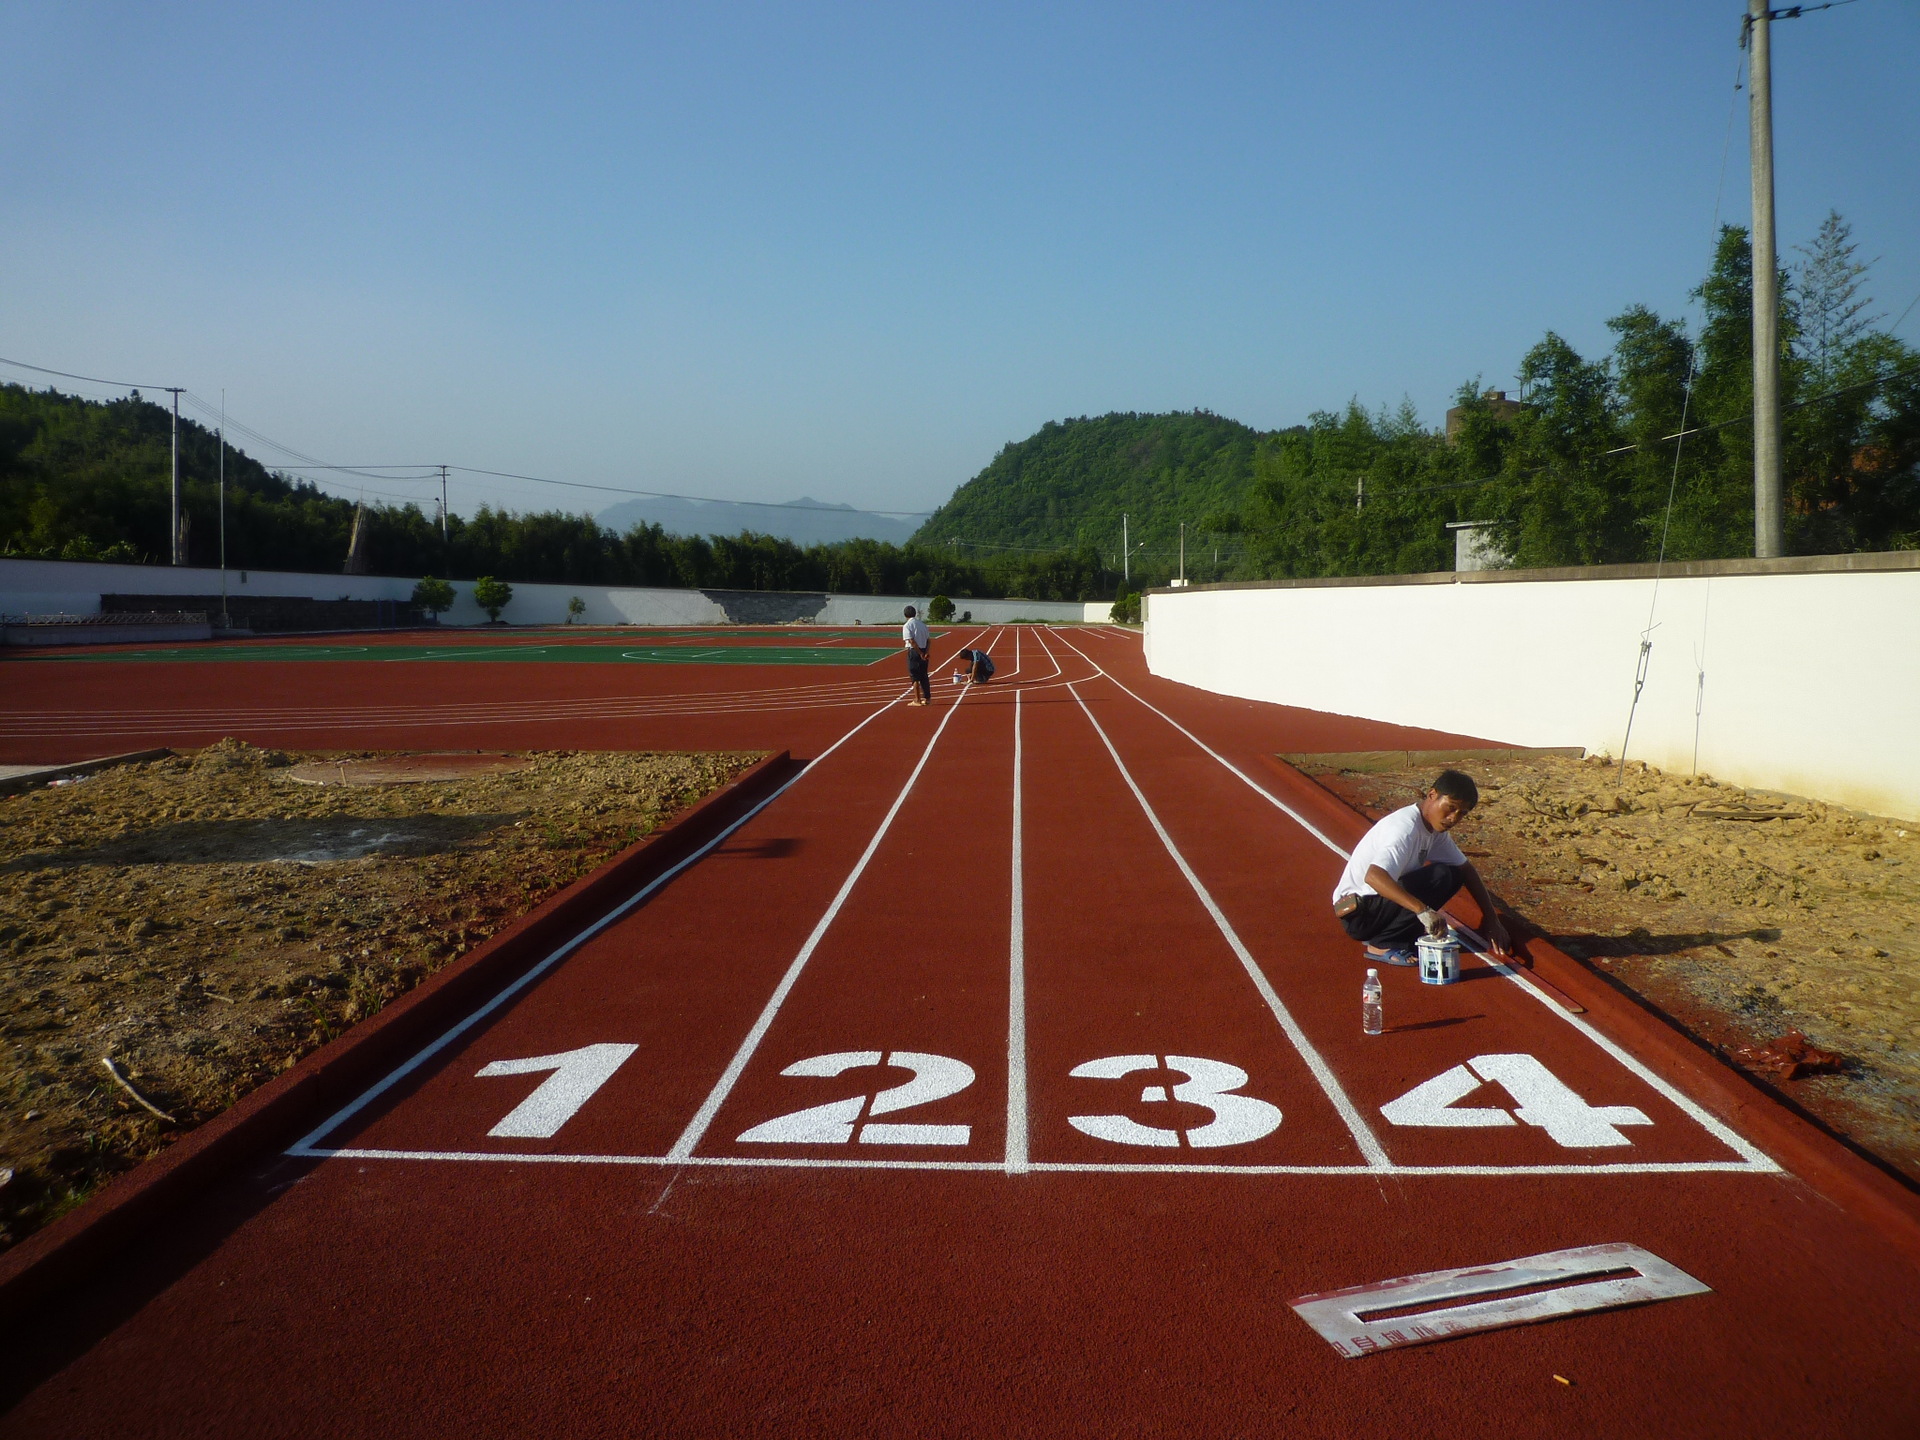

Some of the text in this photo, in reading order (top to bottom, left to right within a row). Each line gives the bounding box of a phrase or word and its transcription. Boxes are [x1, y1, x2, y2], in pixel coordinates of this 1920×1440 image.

[475, 1043, 1655, 1149] 1 2 3 4
